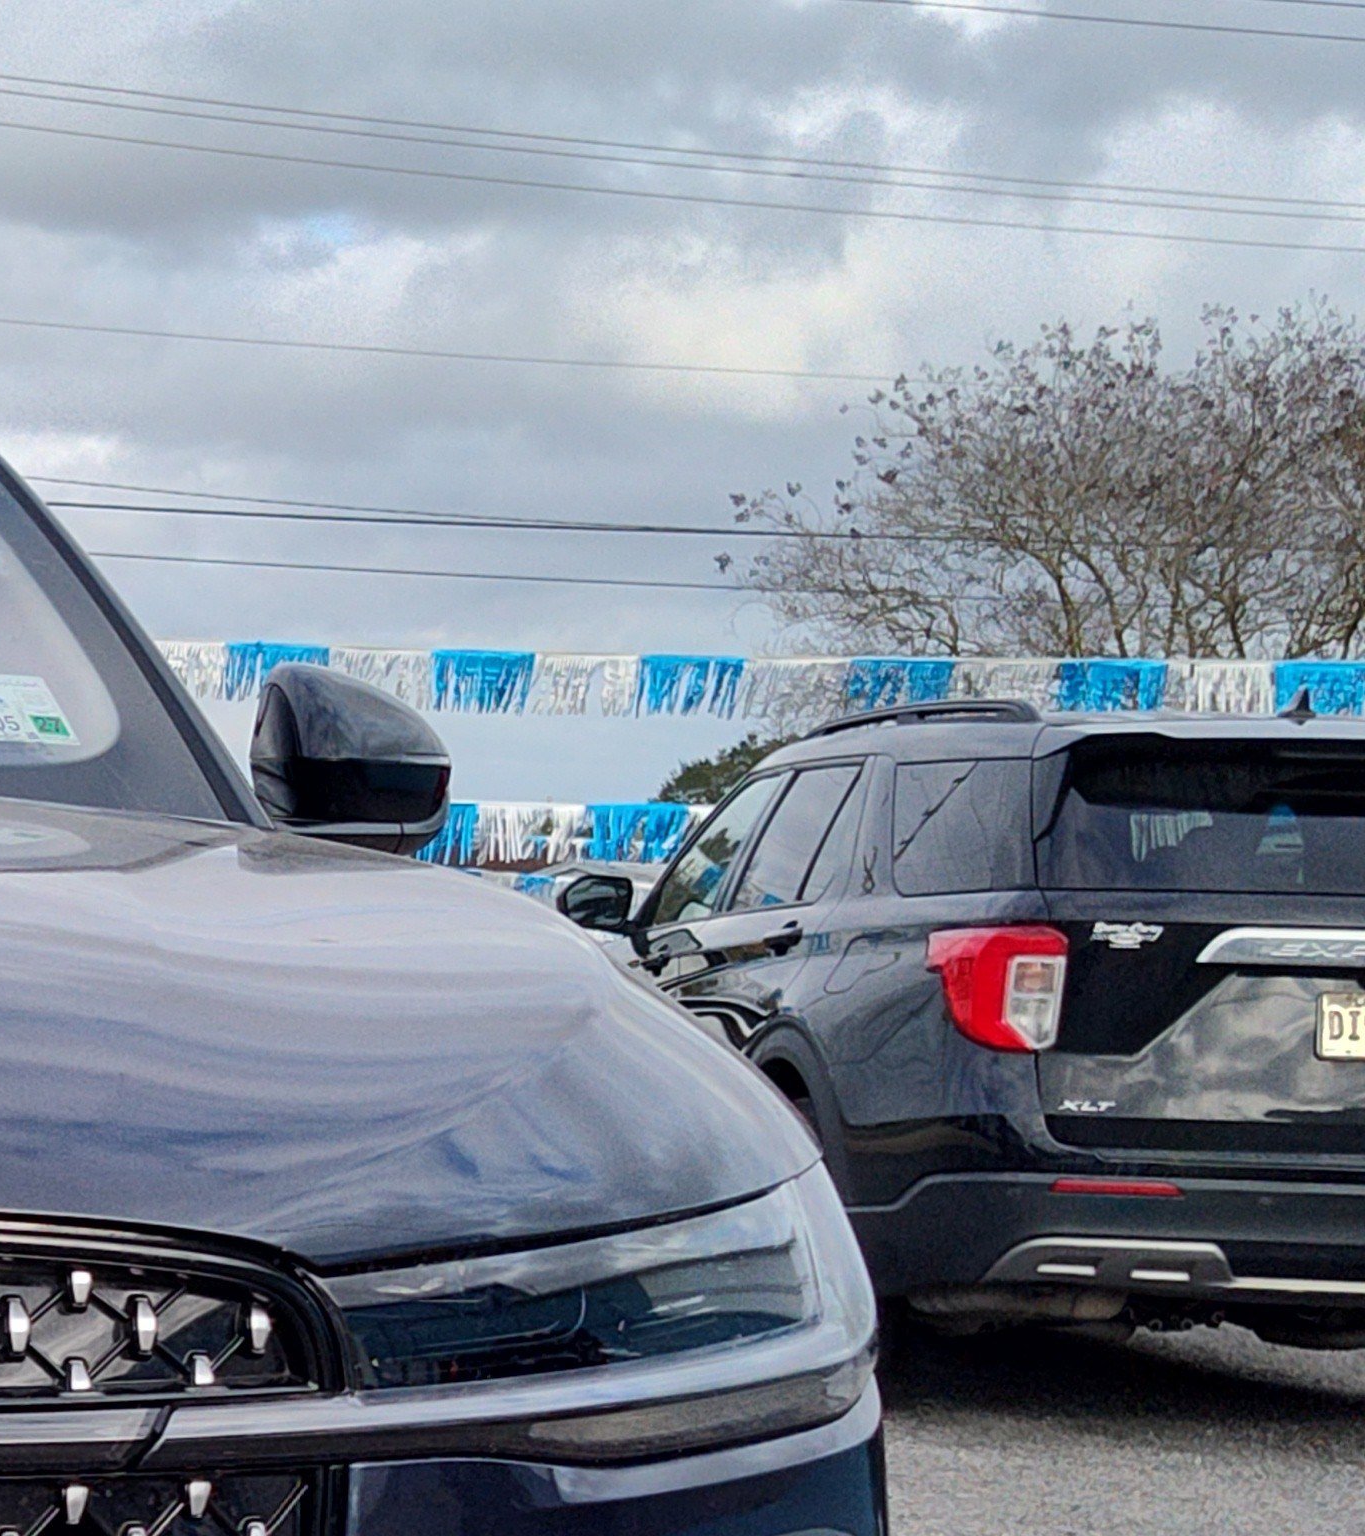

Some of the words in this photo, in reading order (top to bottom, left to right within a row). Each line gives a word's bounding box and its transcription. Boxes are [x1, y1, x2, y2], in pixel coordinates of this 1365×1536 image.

[37, 716, 62, 733] 27
[1328, 1010, 1365, 1041] DI
[1058, 1099, 1117, 1112] XLT
